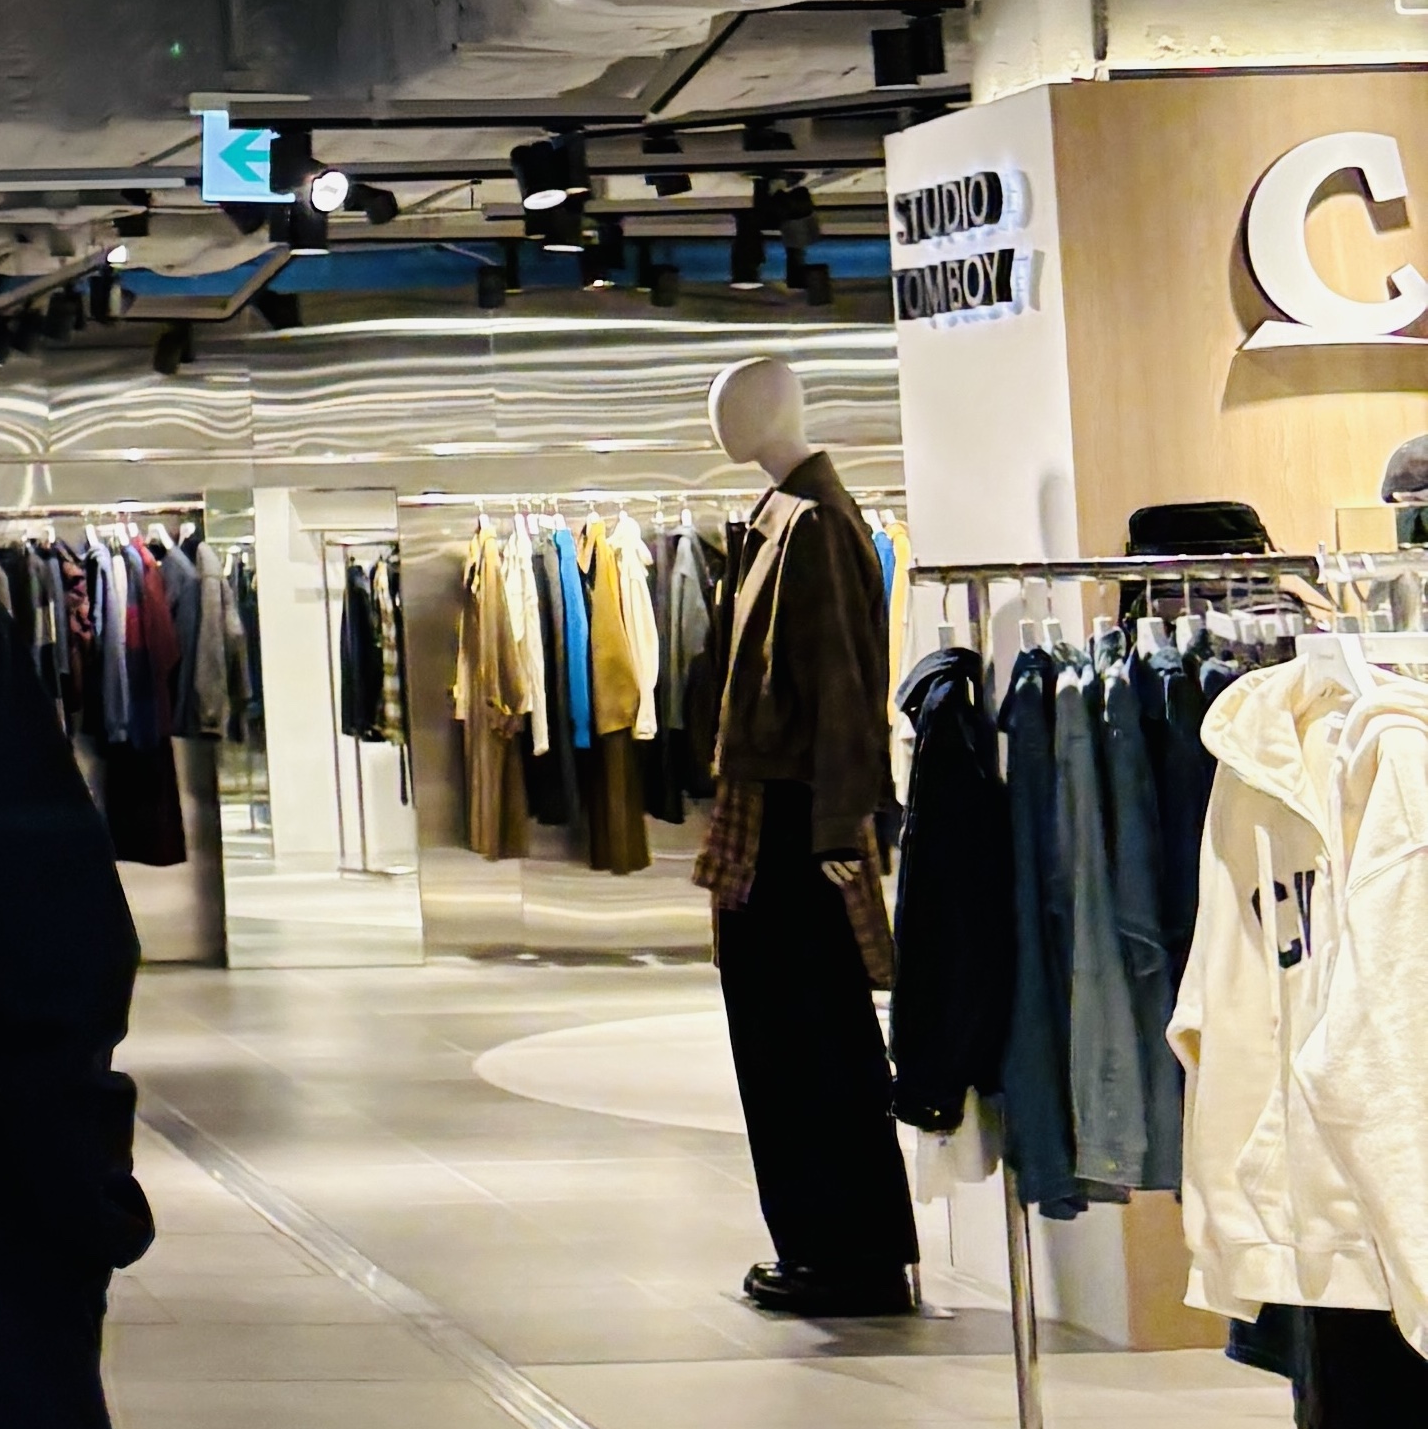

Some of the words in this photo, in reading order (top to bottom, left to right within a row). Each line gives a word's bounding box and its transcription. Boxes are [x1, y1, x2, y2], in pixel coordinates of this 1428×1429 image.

[895, 171, 1002, 245] STUDIO
[1246, 131, 1428, 340] C
[892, 248, 1013, 320] TOMBOY
